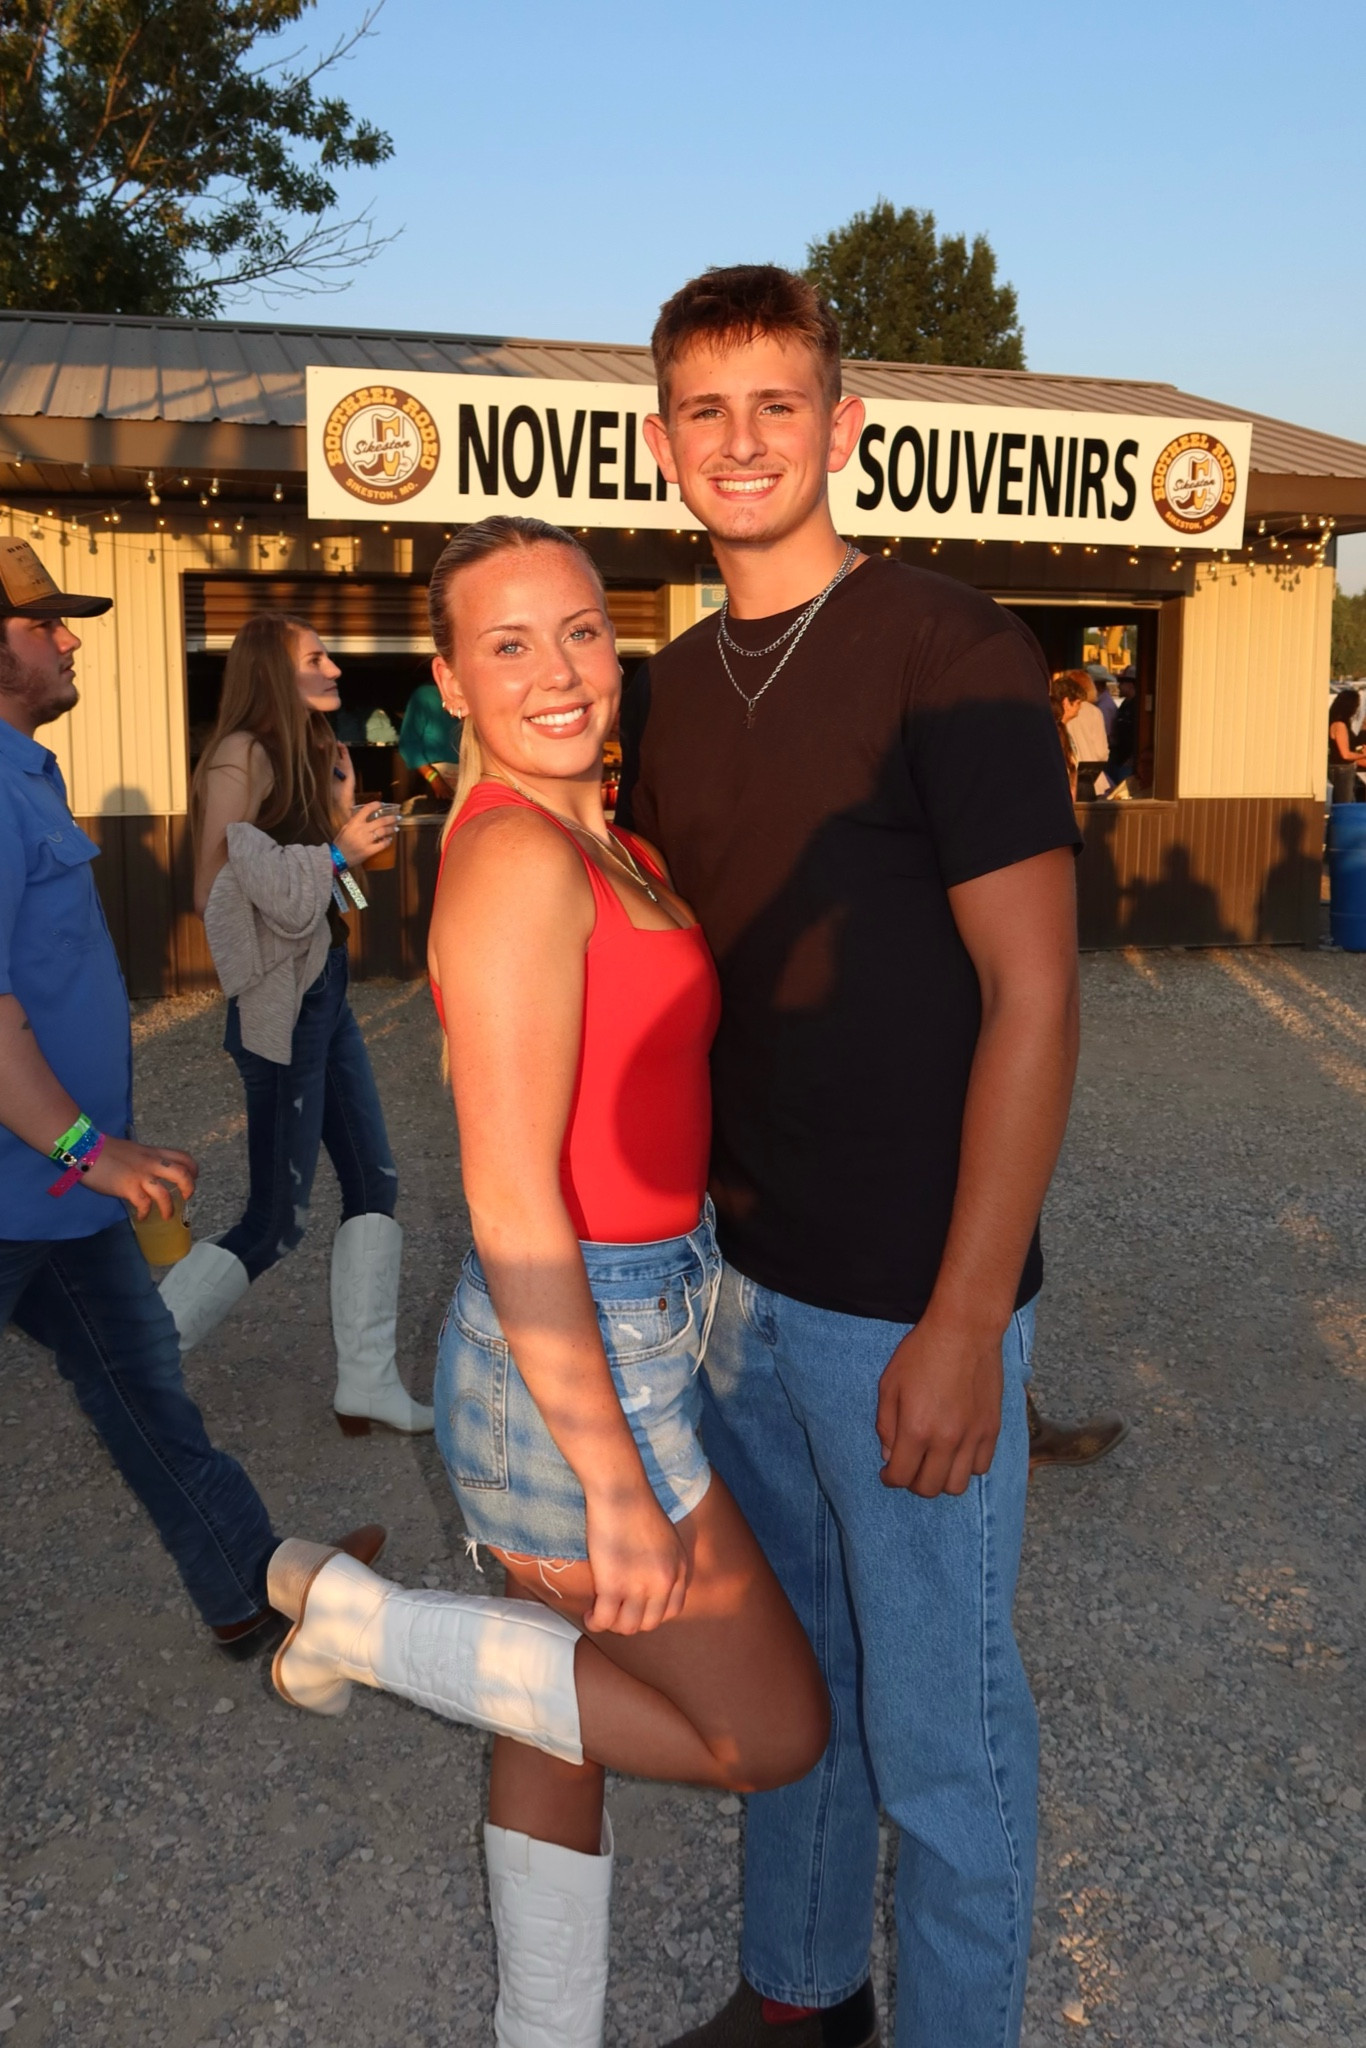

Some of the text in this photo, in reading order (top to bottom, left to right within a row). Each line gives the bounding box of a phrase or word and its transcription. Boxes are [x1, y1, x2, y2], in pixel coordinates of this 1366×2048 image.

[325, 387, 439, 471] BOOTHEEL RODEO
[353, 439, 412, 455] Sikeston
[458, 404, 685, 502] NOVEL
[1153, 433, 1235, 505] BOOTHEEL RODEO
[856, 423, 1139, 521] SOUVENIRS
